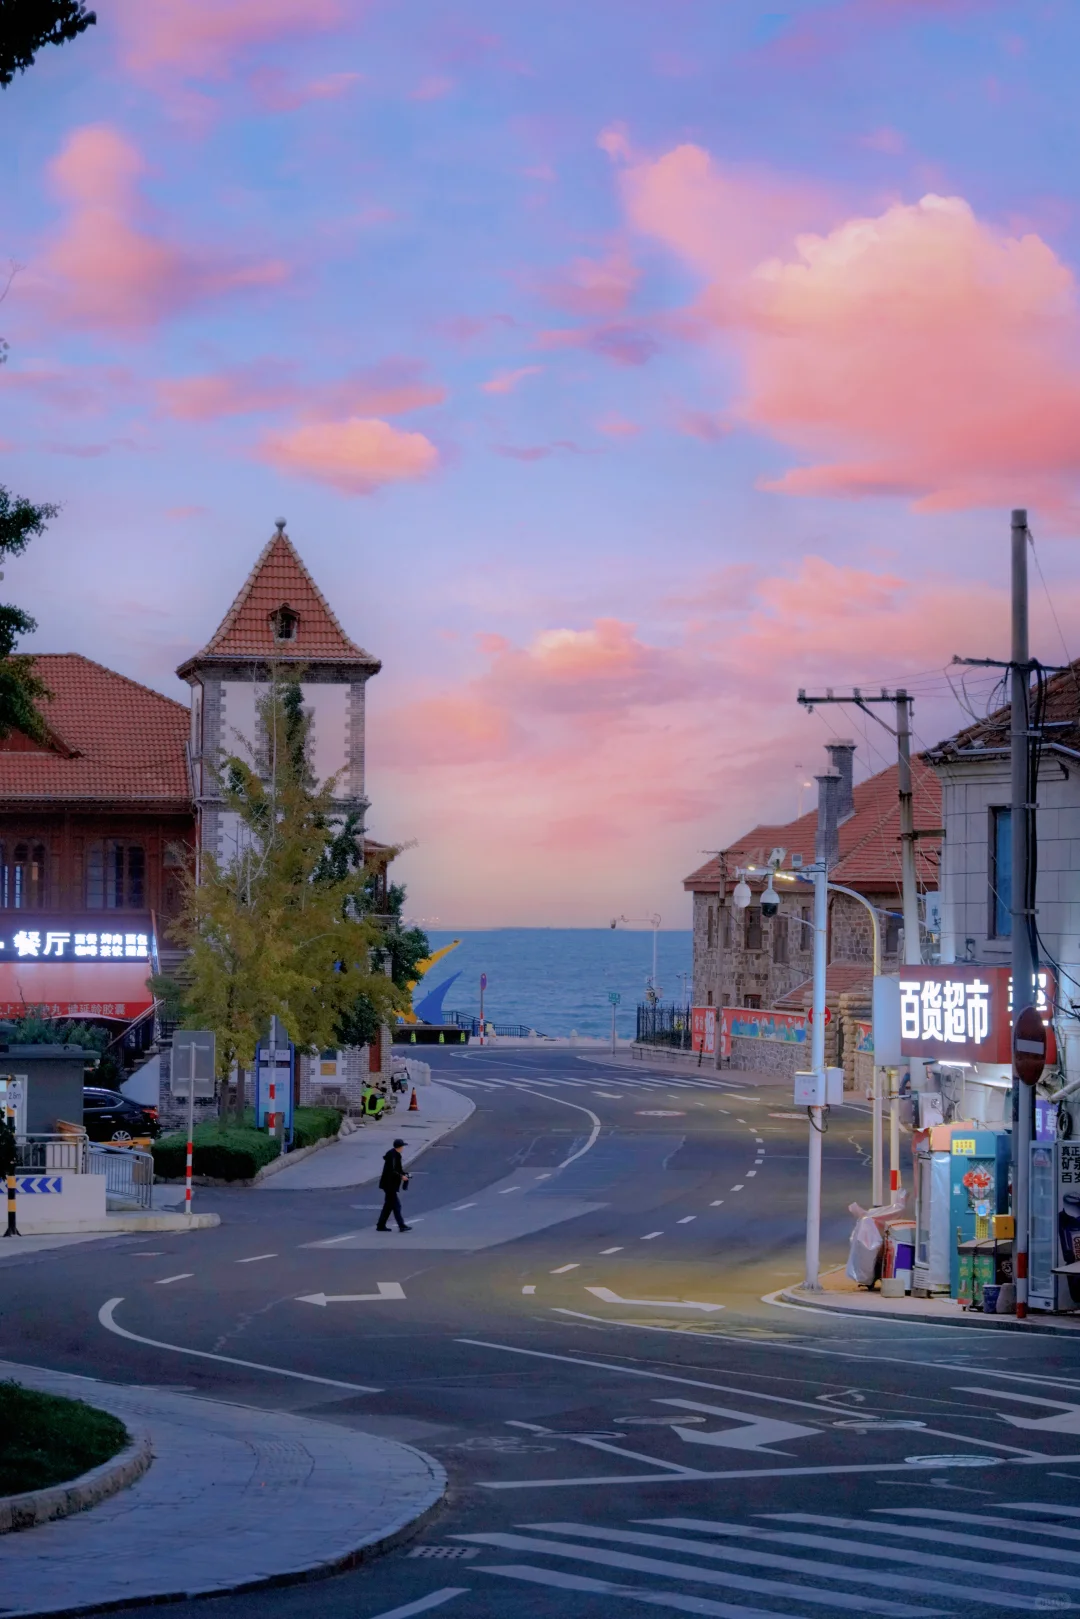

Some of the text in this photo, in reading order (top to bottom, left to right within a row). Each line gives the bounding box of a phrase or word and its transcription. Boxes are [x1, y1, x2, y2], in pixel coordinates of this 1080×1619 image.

[13, 930, 71, 957] 餐厅
[899, 979, 989, 1044] 百货超市
